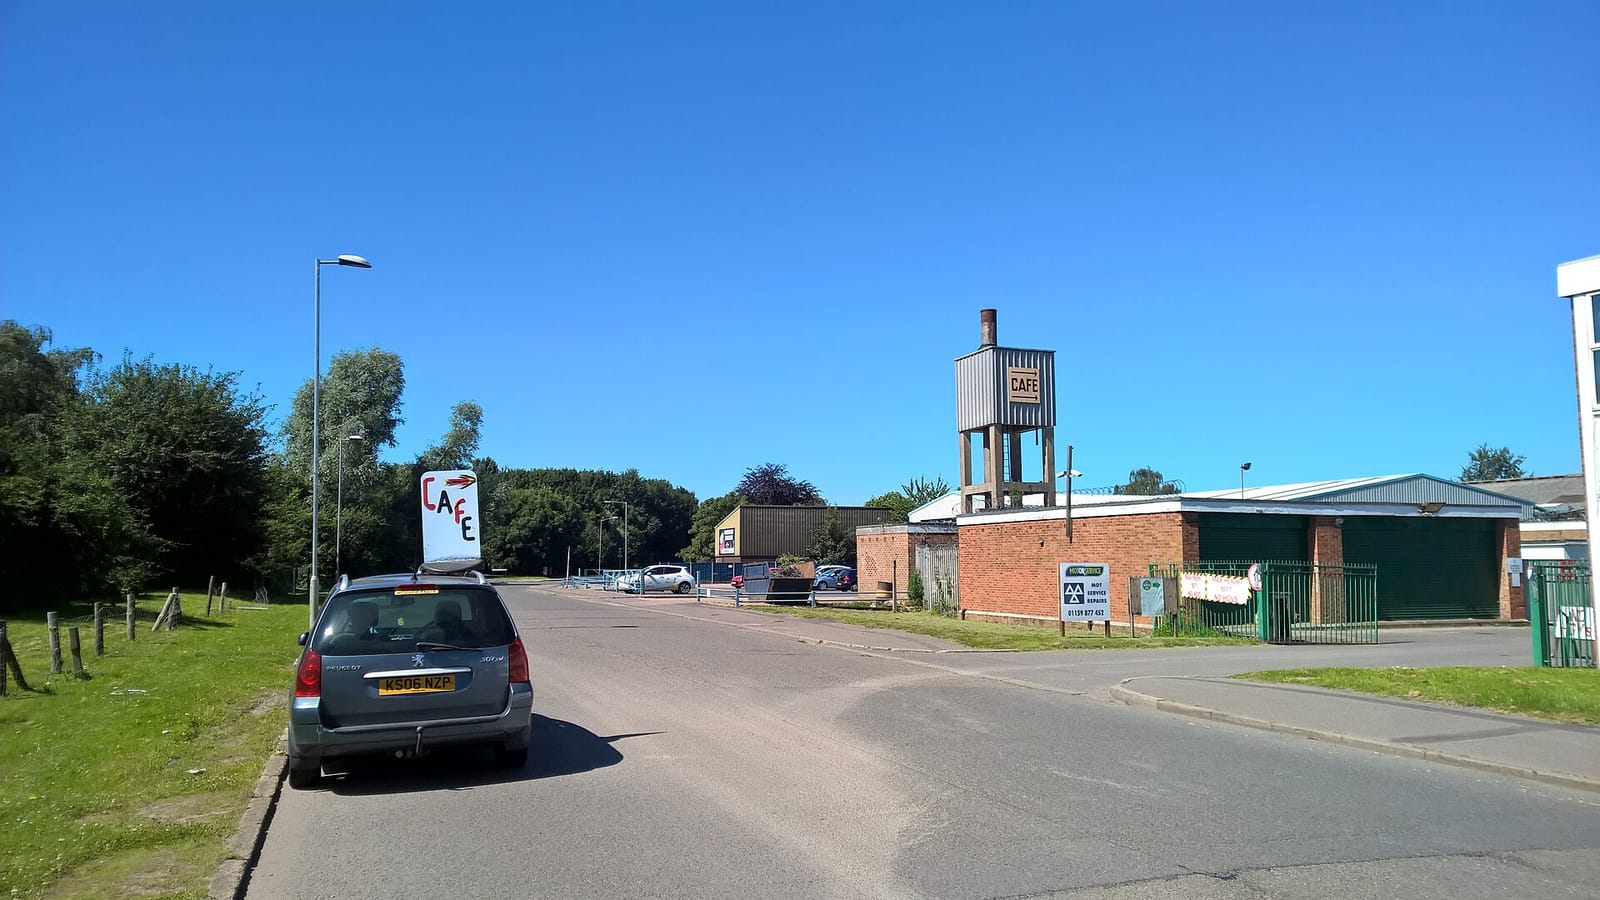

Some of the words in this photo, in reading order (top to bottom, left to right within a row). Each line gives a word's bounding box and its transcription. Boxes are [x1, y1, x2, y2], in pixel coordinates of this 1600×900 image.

[1011, 377, 1038, 392] CAFE
[422, 477, 476, 541] CAFE
[385, 678, 421, 691] KS06
[425, 676, 450, 689] NZP
